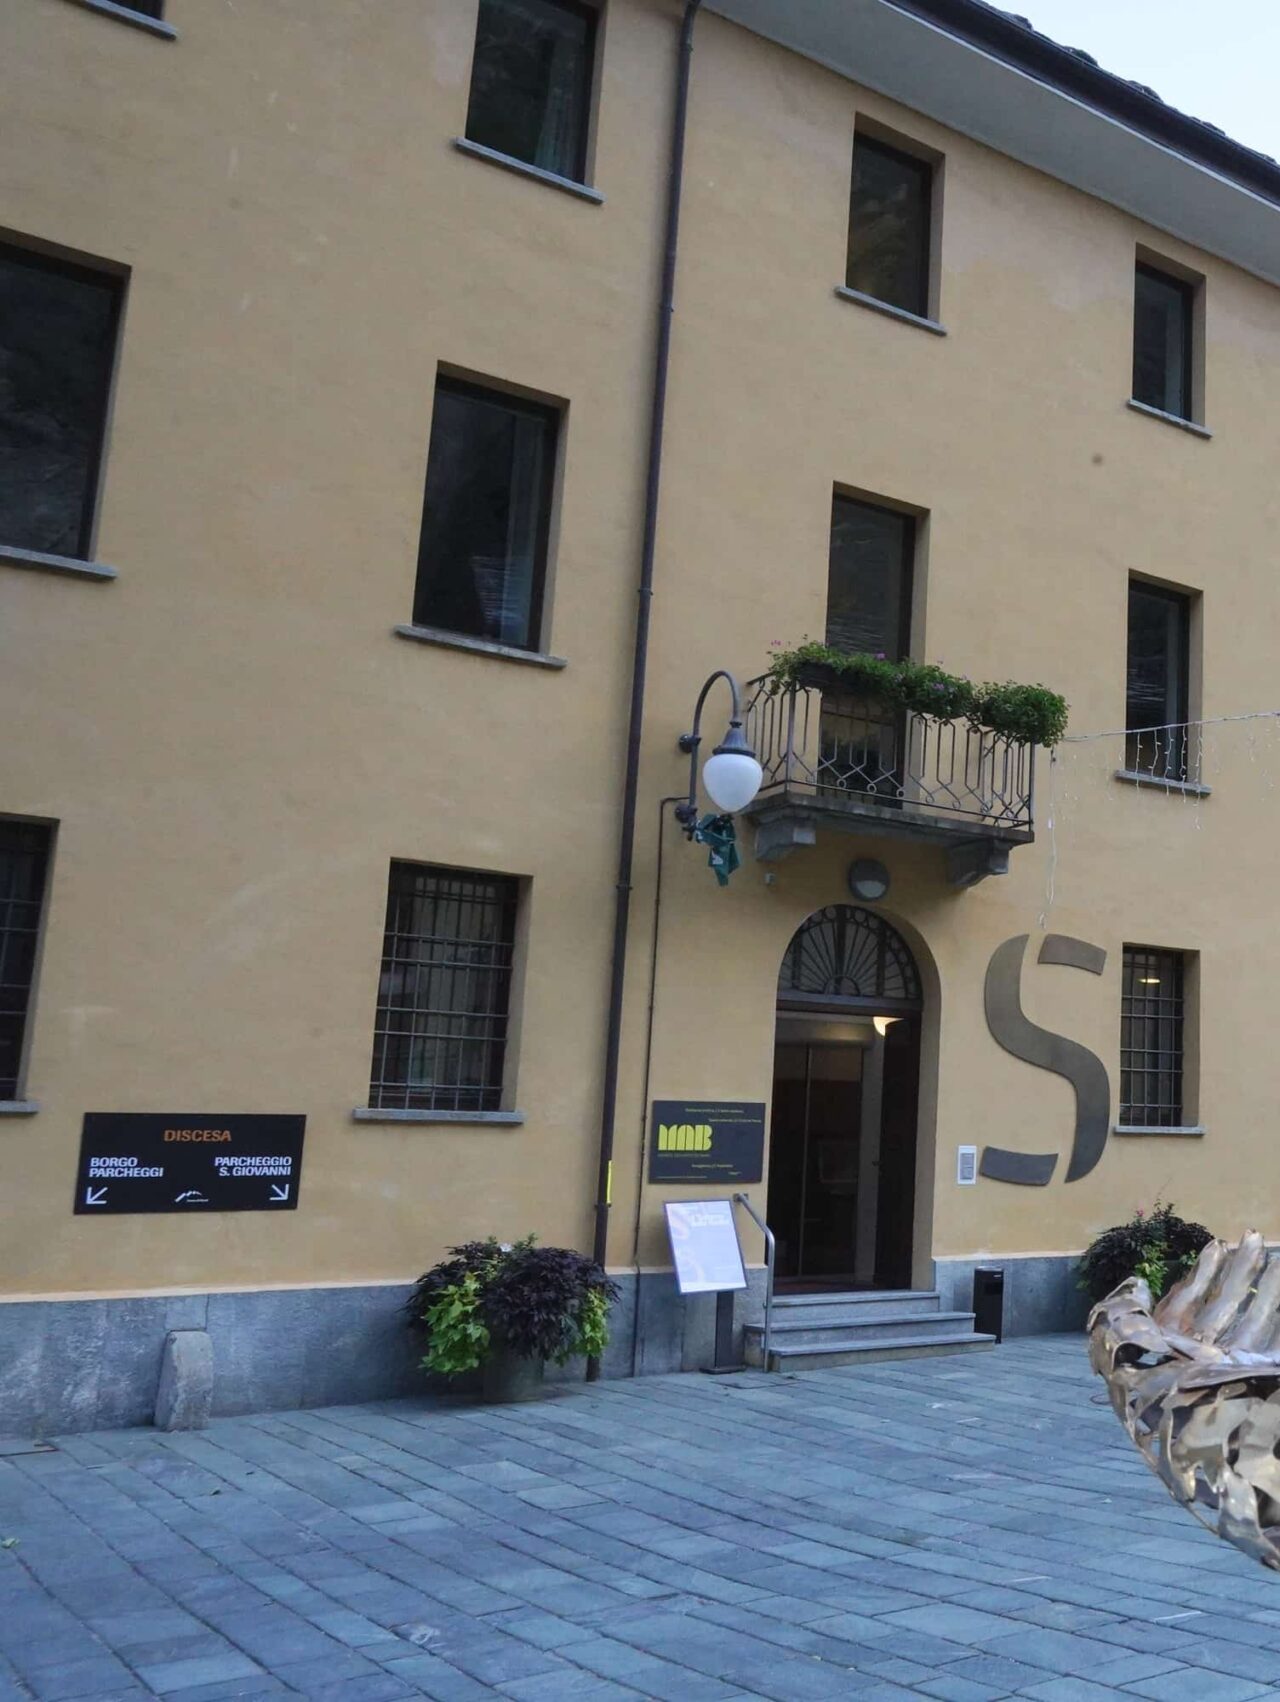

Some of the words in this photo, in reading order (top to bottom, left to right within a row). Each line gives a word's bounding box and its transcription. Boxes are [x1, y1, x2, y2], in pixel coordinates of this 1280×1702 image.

[163, 1129, 232, 1142] DISCESA
[657, 1124, 713, 1151] MAB
[90, 1157, 138, 1167] BORGO
[214, 1156, 292, 1167] PARCHEGGIO
[88, 1167, 164, 1178] PARCHEGGI
[219, 1166, 230, 1177] S.
[232, 1166, 291, 1177] GIOVANNI
